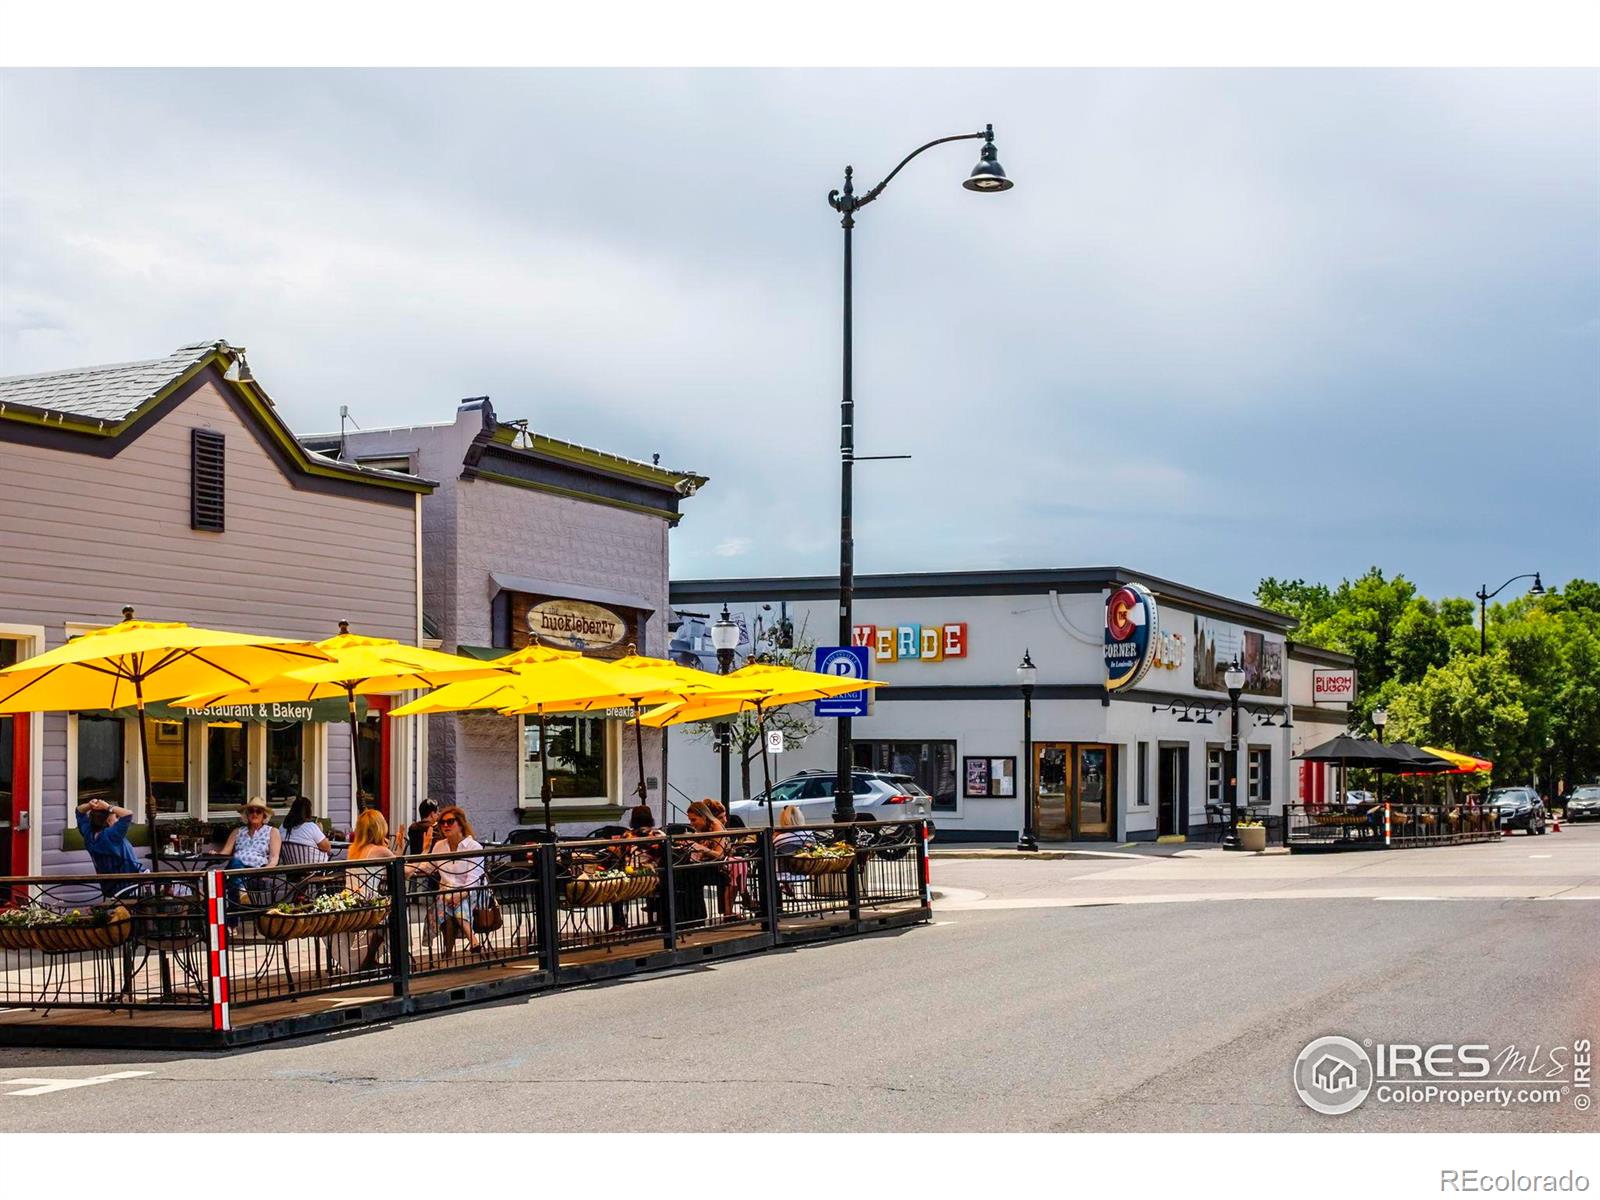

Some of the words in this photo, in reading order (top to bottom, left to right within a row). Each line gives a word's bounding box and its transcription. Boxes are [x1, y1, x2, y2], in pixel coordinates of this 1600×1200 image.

[541, 611, 616, 640] huckleberry
[853, 625, 961, 659] VERDE
[1104, 642, 1137, 658] CORNER
[259, 704, 268, 718] &
[273, 703, 313, 720] Bakery
